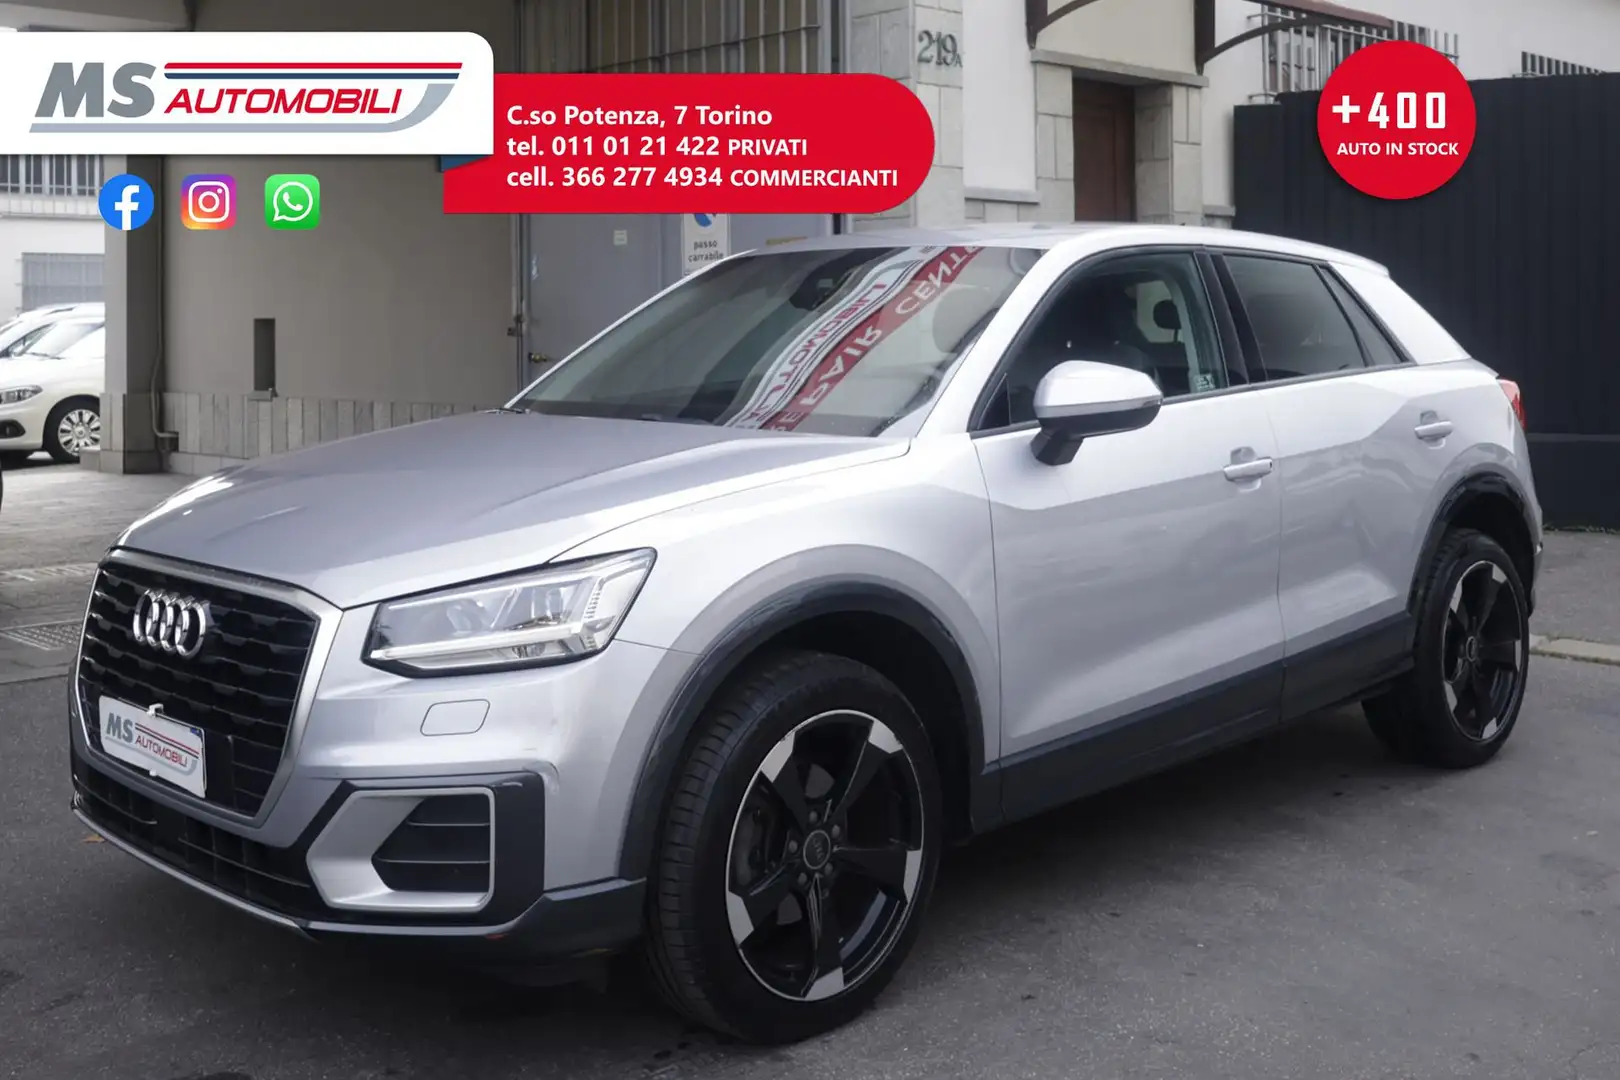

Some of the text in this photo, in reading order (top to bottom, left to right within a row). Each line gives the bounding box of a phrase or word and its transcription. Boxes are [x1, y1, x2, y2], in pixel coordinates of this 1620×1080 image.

[693, 240, 718, 251] passo
[688, 250, 724, 263] carrabile
[106, 712, 188, 768] MS AUTOMOBILI
